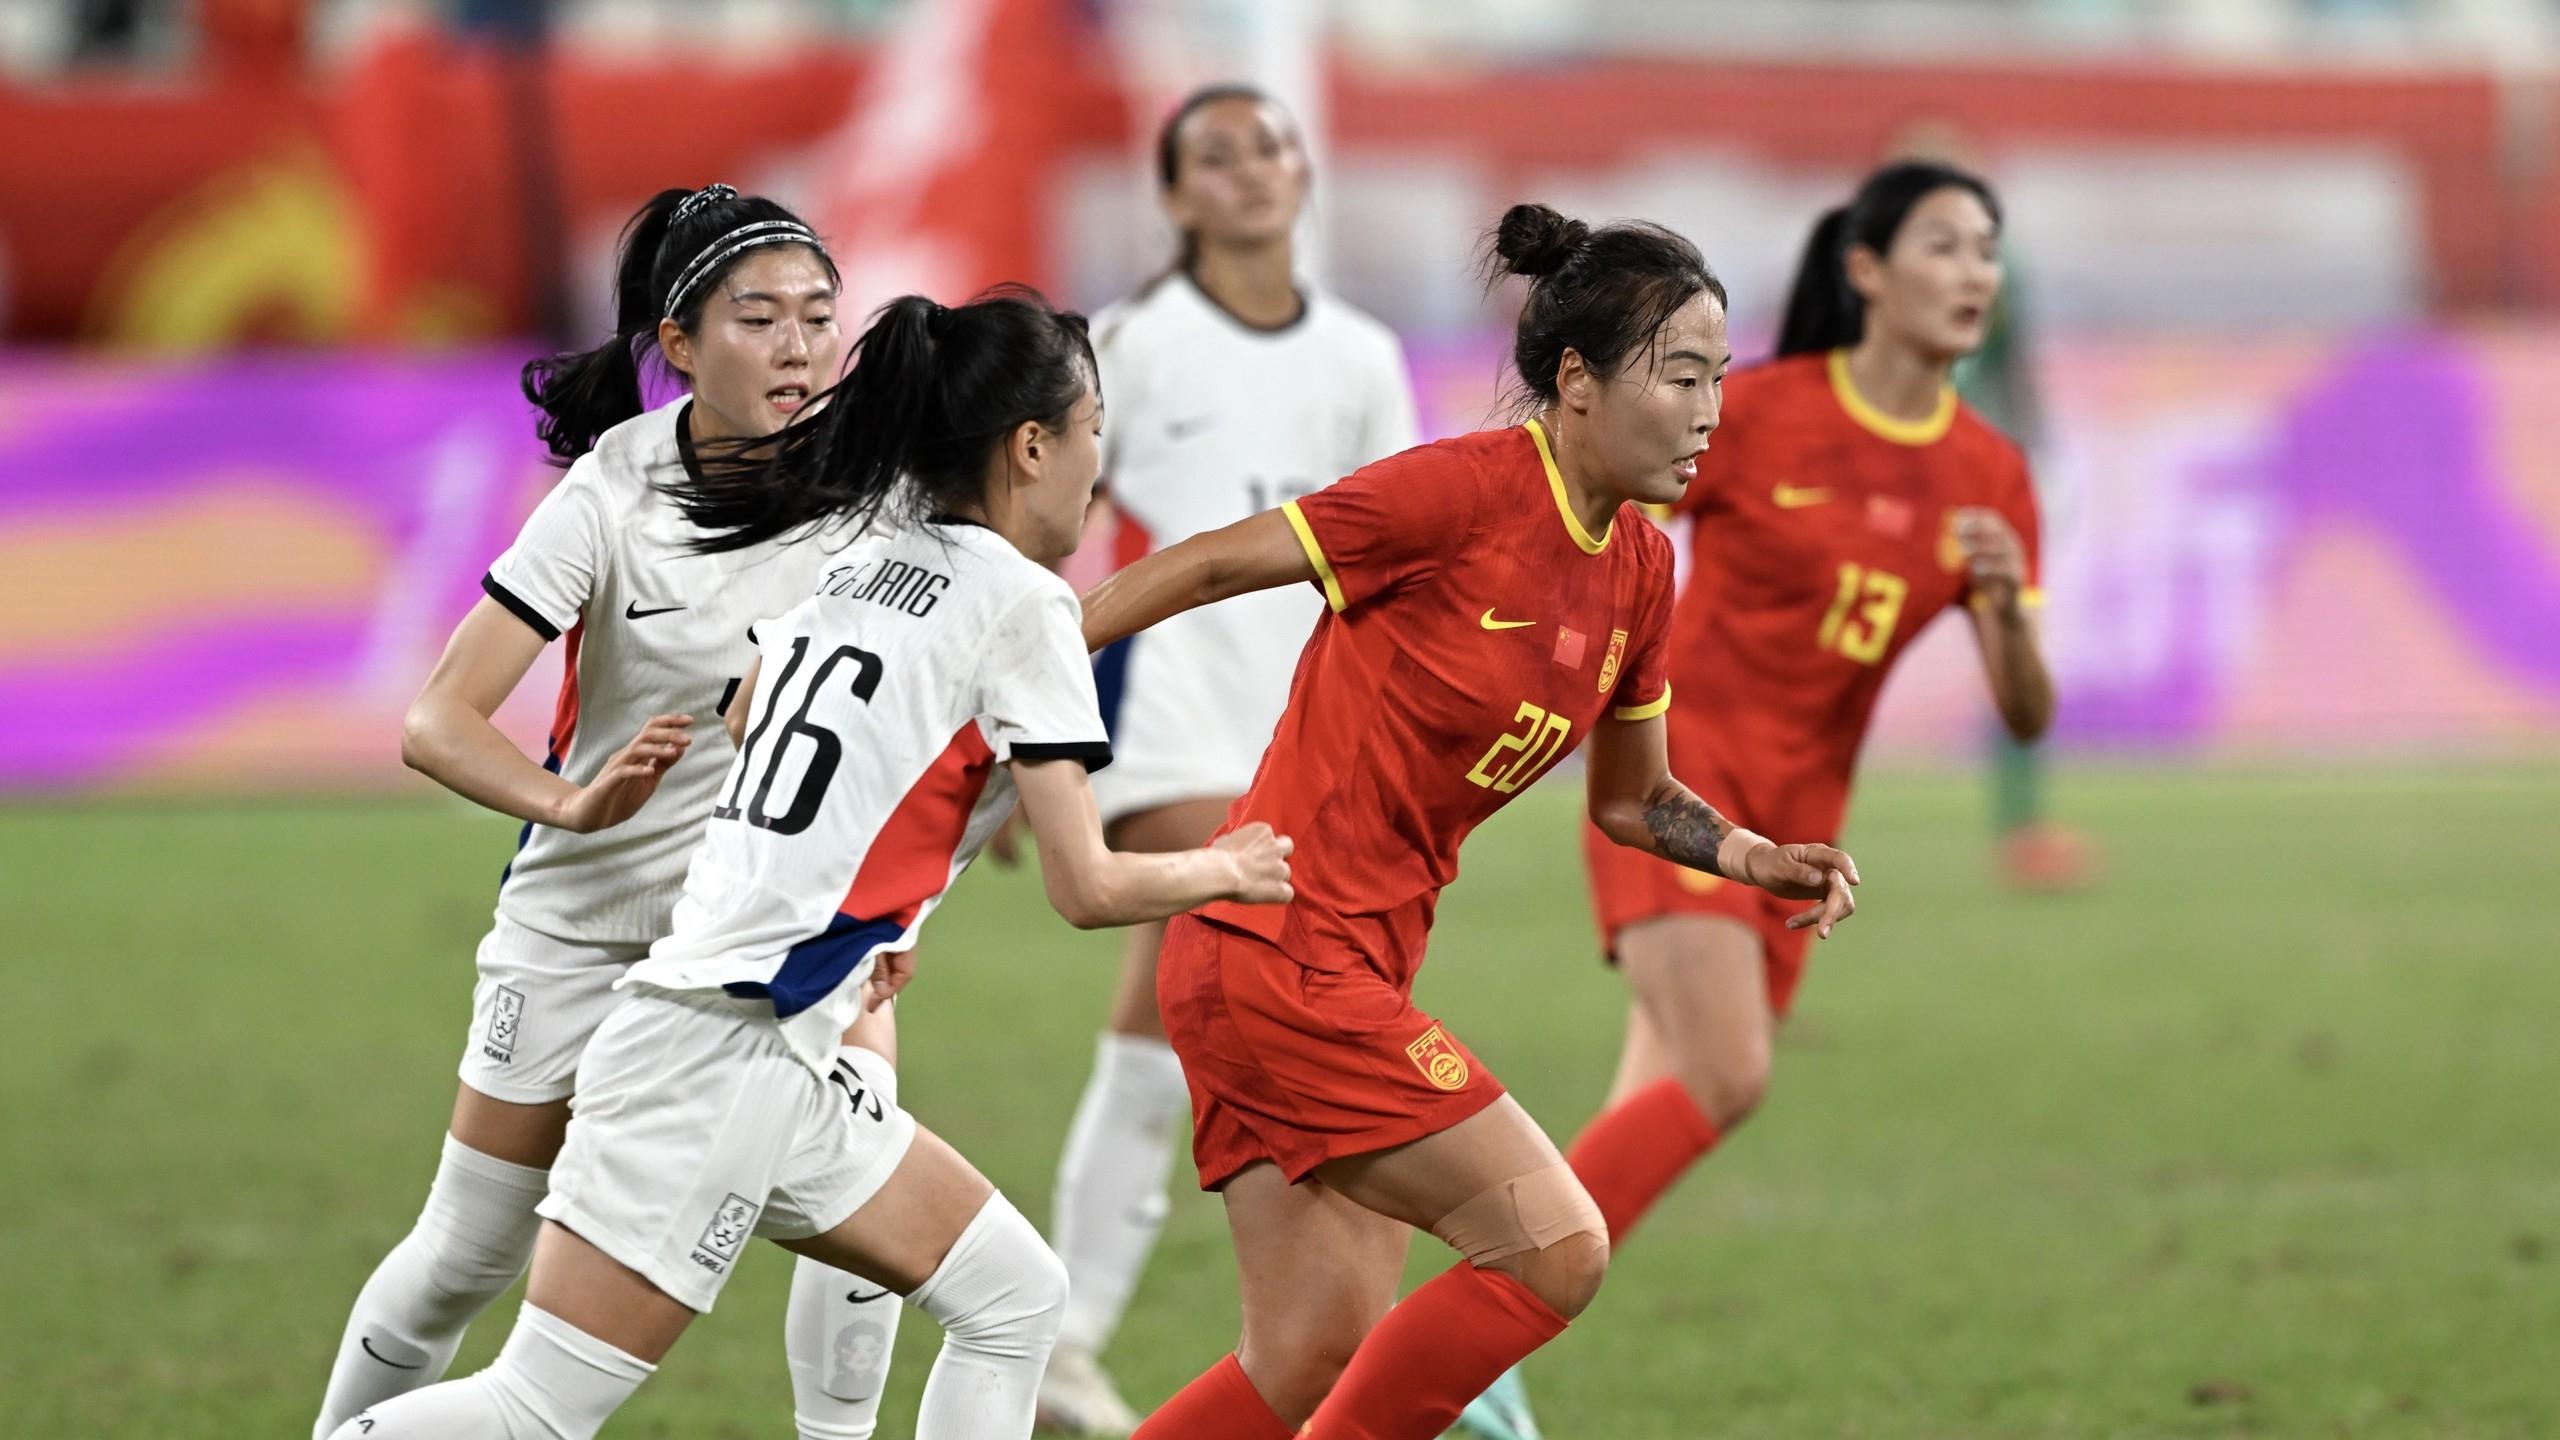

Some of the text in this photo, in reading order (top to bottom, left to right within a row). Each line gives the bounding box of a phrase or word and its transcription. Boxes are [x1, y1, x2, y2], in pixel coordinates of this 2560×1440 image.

[852, 558, 951, 618] JANG
[1818, 560, 1909, 666] 13
[712, 636, 884, 836] 16
[1464, 700, 1572, 794] 20
[483, 1045, 512, 1065] KOREA
